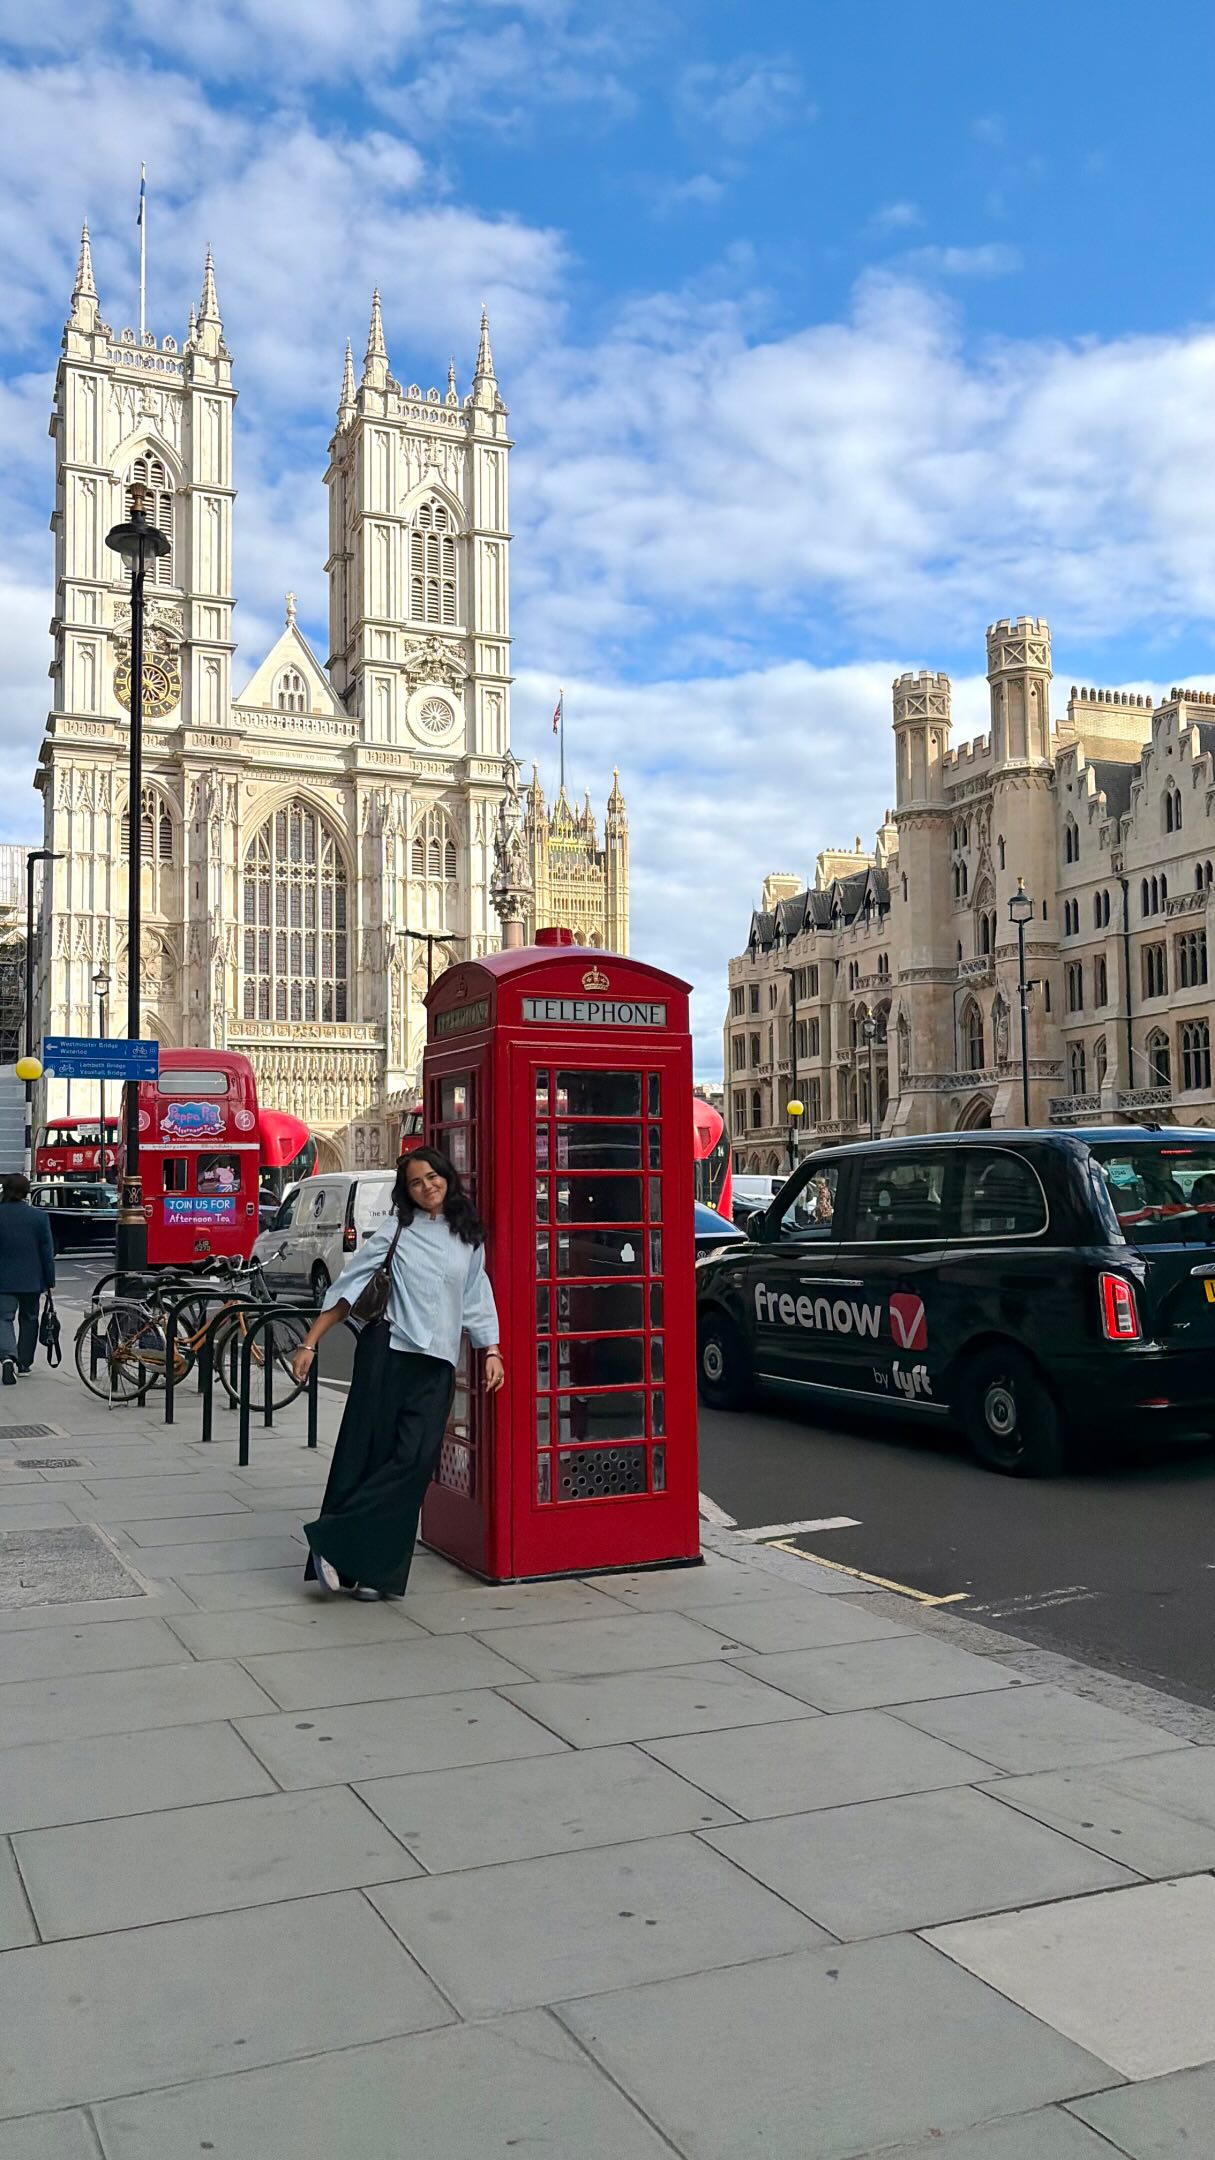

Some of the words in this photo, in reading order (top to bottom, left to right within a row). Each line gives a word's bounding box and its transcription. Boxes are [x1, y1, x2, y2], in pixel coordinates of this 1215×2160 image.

[437, 1001, 488, 1035] TELEPHONE
[527, 999, 661, 1025] TELEPHONE
[98, 1042, 119, 1050] Bridge
[170, 1106, 200, 1123] Peppa
[201, 1105, 217, 1123] Pig
[173, 1124, 204, 1134] Afternoon
[203, 1124, 214, 1132] Tea
[169, 1199, 193, 1209] JOIN
[195, 1199, 208, 1209] US
[210, 1199, 230, 1209] FOR
[169, 1213, 212, 1223] Afternoon
[215, 1213, 230, 1222] Tea
[754, 1282, 882, 1338] freenow
[872, 1367, 889, 1389] by
[892, 1360, 933, 1399] lyft
